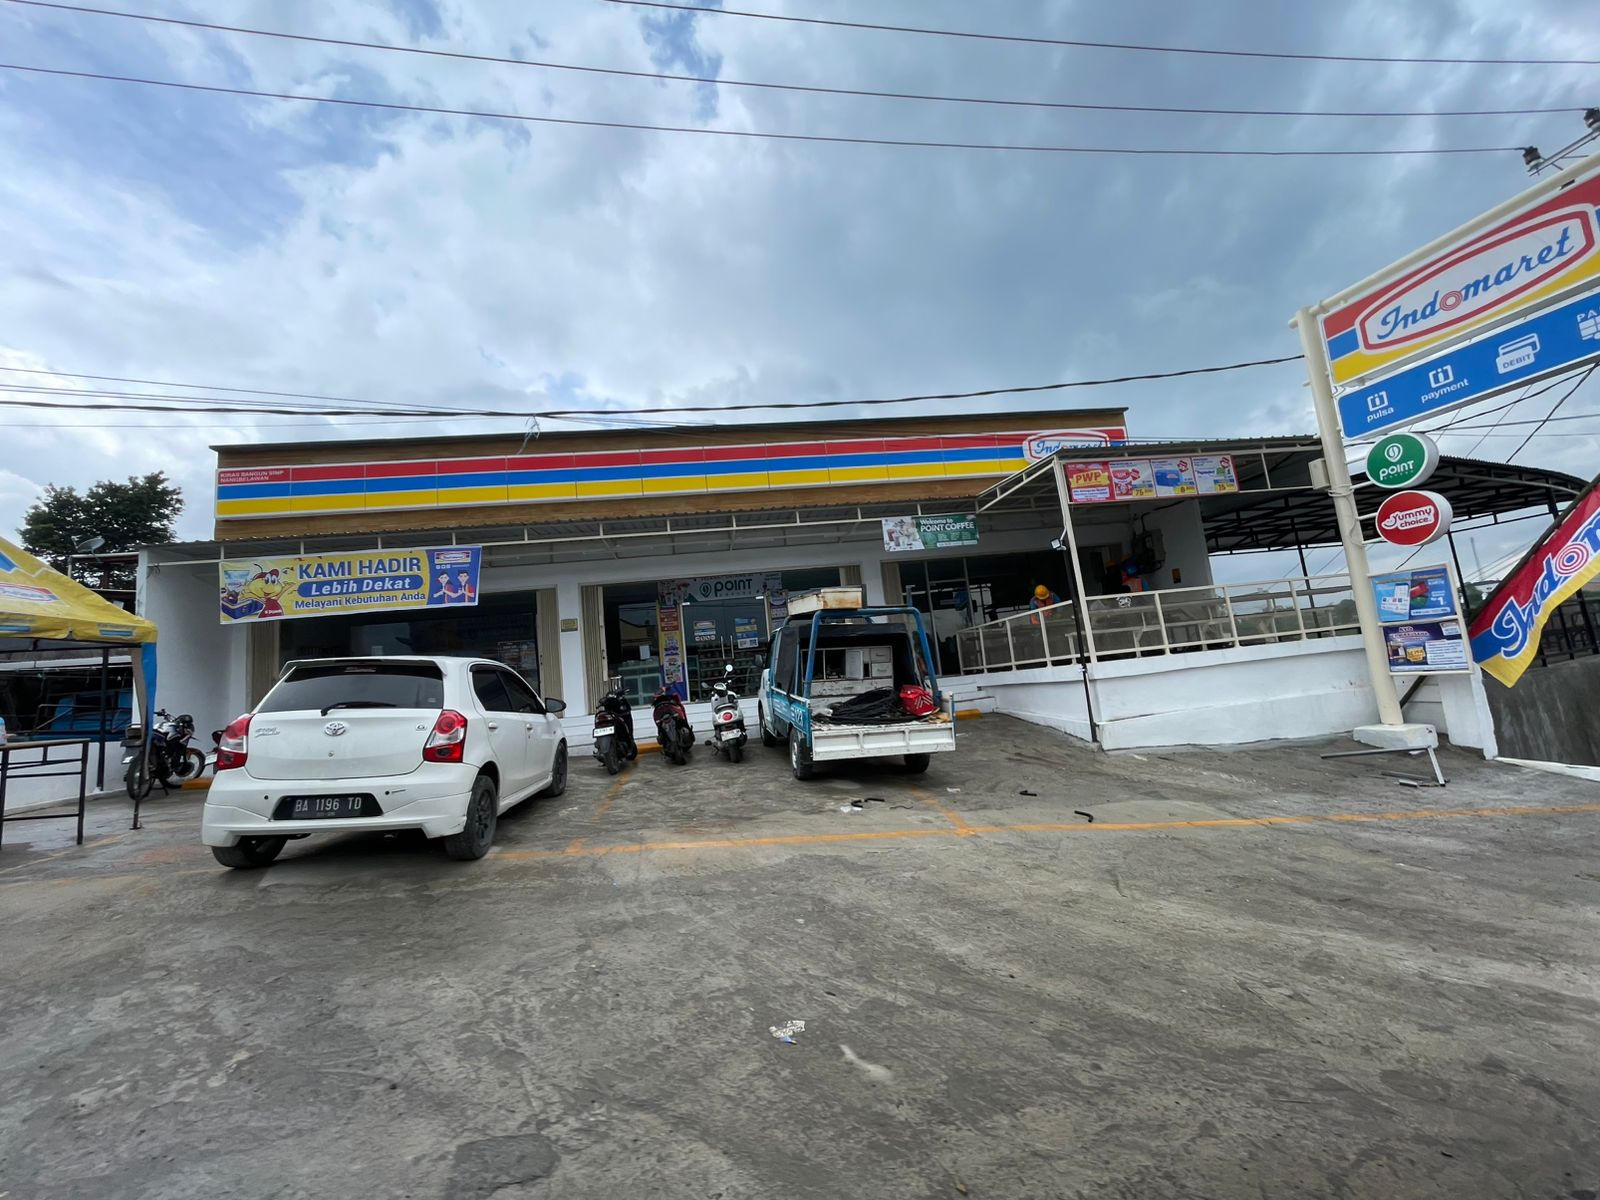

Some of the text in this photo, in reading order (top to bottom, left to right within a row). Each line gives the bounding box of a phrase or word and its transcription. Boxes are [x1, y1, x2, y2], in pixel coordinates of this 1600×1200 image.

[1376, 226, 1575, 340] Indomaret
[1576, 306, 1600, 323] PA
[1502, 353, 1532, 369] DEBIT
[1421, 378, 1469, 403] payment
[1366, 407, 1395, 423] pulsa
[1075, 471, 1102, 484] PWP
[1386, 508, 1432, 526] Yummy
[1400, 517, 1429, 528] choice
[920, 522, 975, 532] POINT COFFEE
[299, 557, 421, 580] KAMI HADIR
[311, 578, 411, 596] Lebih Dekat
[714, 579, 753, 597] POINT
[295, 593, 426, 610] Melayani Kebutuhan Anda
[295, 797, 362, 812] BA 1196 TD
